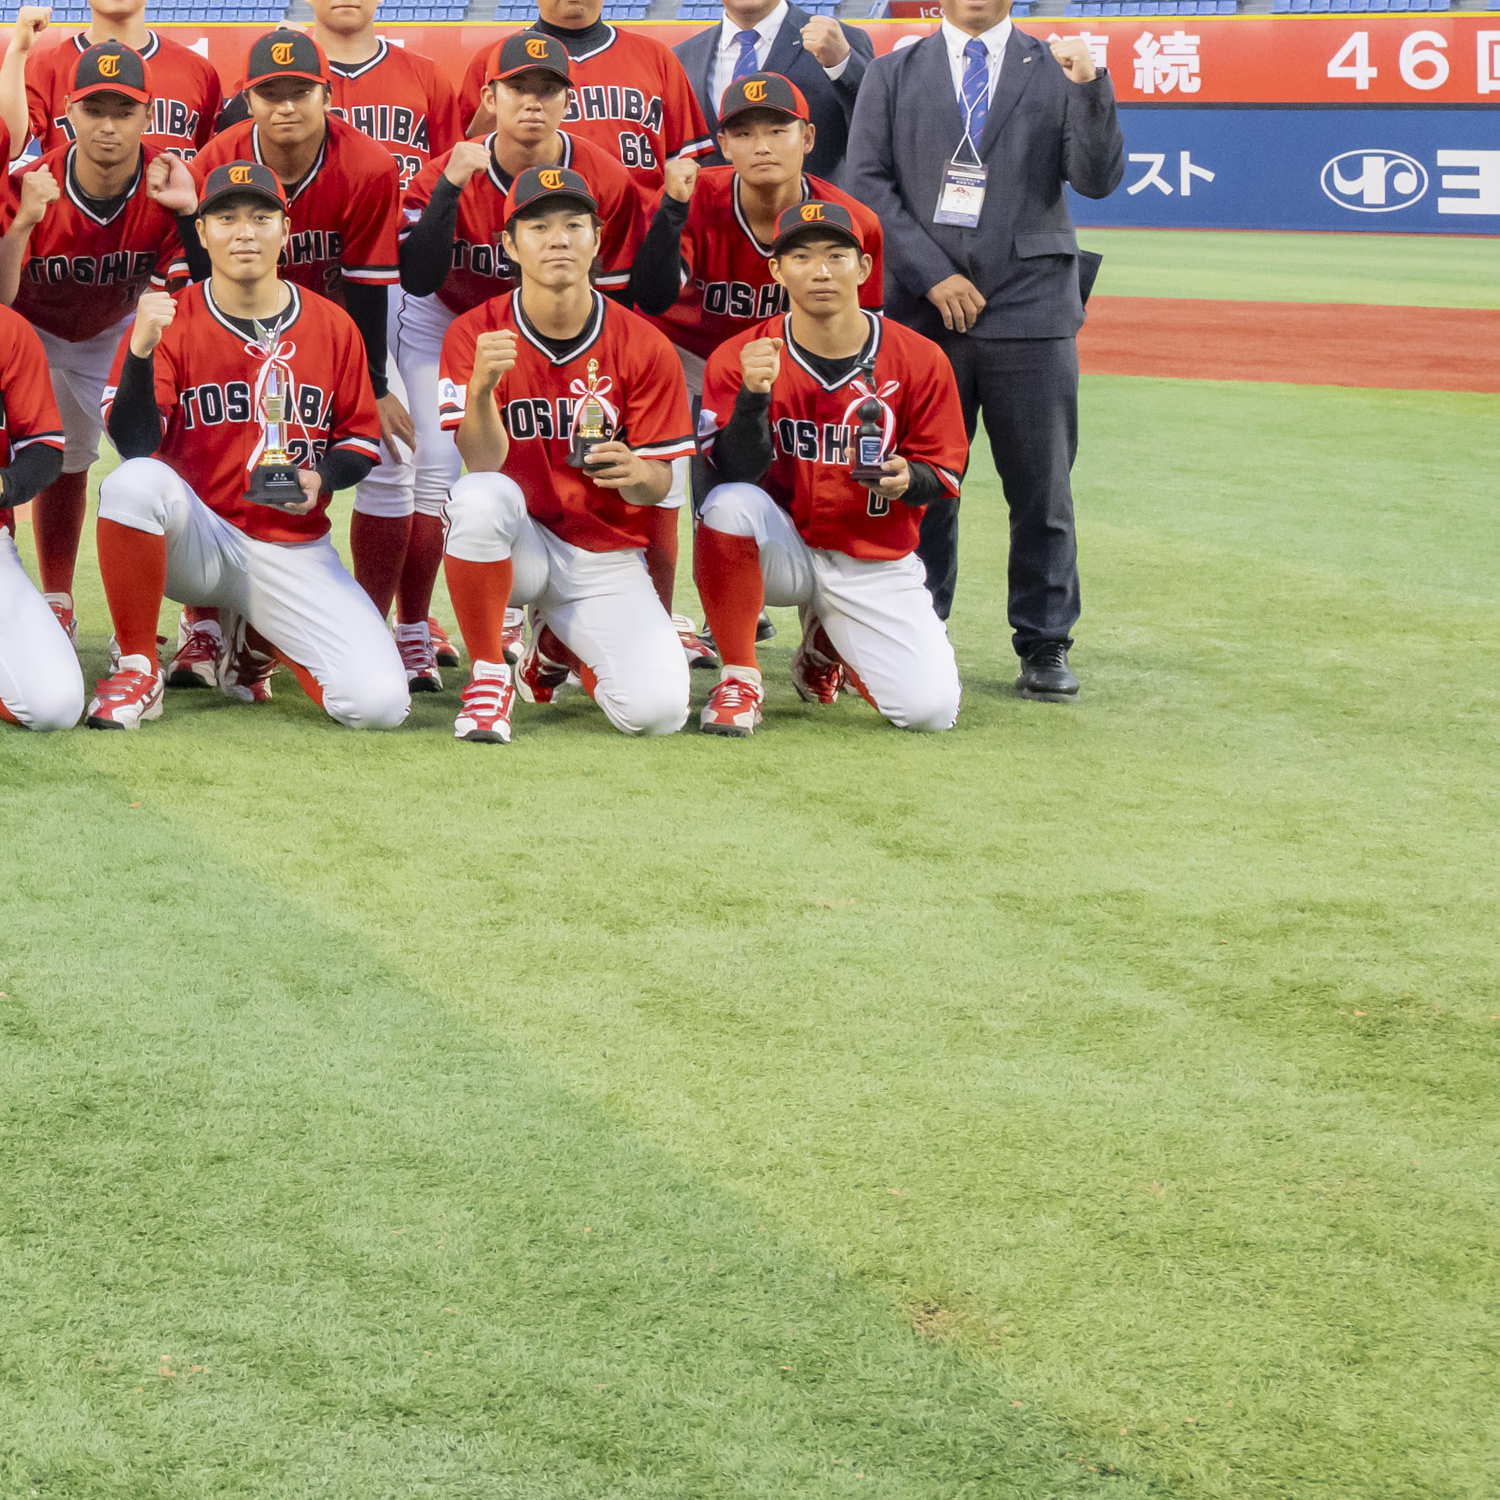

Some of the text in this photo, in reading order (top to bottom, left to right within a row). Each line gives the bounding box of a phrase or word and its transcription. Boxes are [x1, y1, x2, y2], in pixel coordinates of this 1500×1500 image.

[560, 85, 664, 135] SHIBA
[618, 131, 658, 170] 66
[28, 250, 158, 286] TOSHIB
